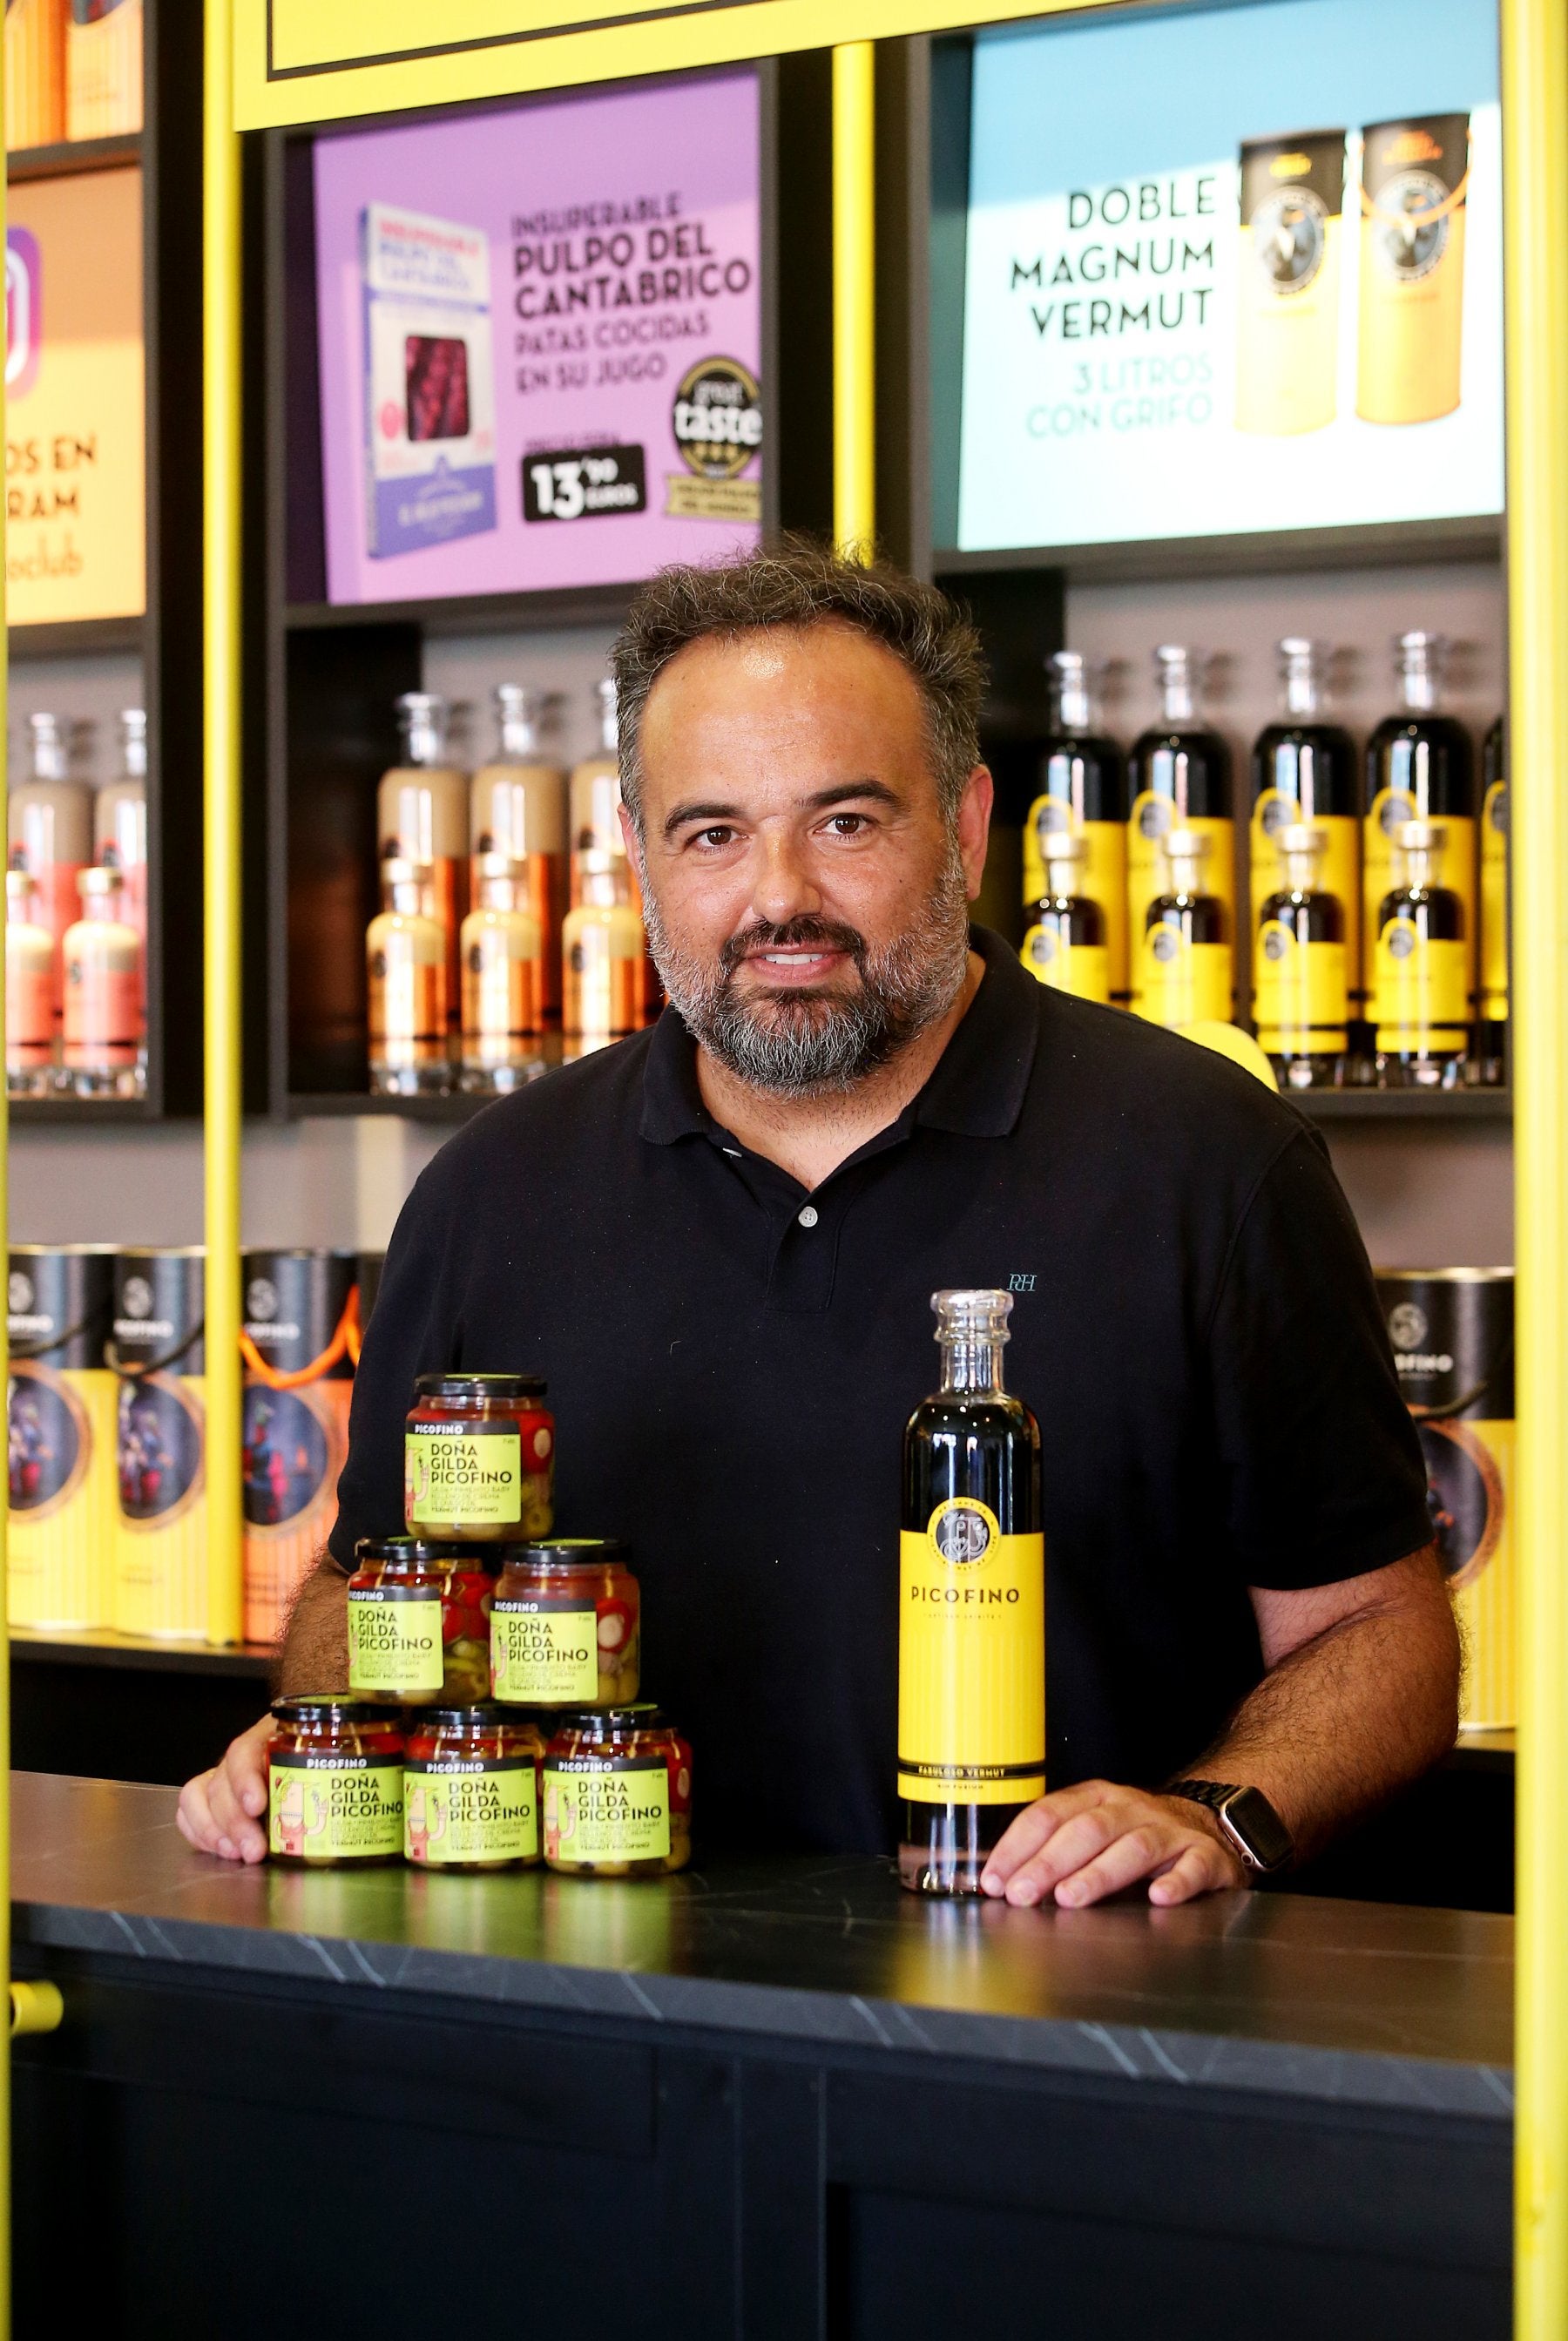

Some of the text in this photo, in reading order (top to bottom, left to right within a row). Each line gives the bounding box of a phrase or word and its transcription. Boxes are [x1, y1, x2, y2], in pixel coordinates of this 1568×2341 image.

[1070, 177, 1215, 229] DOBLE
[515, 233, 634, 276] PULPO
[648, 222, 713, 261] DEL
[1011, 238, 1213, 289] MAGNUM
[516, 258, 750, 319] CANTABRICO
[1031, 288, 1213, 338] VERMUT
[516, 309, 710, 354] PATAS COCIDAS
[517, 352, 667, 393] EN SU JUGO
[1073, 351, 1213, 395] 3 LITROS
[674, 400, 763, 445] taste
[1026, 392, 1213, 438] CON GRIFO
[53, 433, 97, 471] EN
[431, 1440, 478, 1456] DOÑA
[431, 1458, 478, 1470] GILDA
[431, 1471, 512, 1484] PICOFINO
[911, 1586, 1019, 1604] PICOFINO
[358, 1607, 397, 1622] DOÑA
[358, 1625, 398, 1636] GILDA
[509, 1618, 552, 1634] DOÑA
[359, 1638, 433, 1650] PICOFINO
[509, 1635, 553, 1647] GILDA
[509, 1648, 588, 1662] PICOFINO
[306, 1758, 368, 1769] PICOFINO
[426, 1763, 484, 1773] PICOFINO
[558, 1762, 613, 1772] PICOFINO
[918, 1765, 1005, 1778] FABULOSO VERMUT
[331, 1772, 381, 1790] DOÑA
[449, 1777, 499, 1794] DOÑA
[578, 1776, 628, 1793] DOÑA
[331, 1791, 381, 1804] GILDA
[449, 1796, 501, 1808] GILDA
[578, 1796, 629, 1808] GILDA
[331, 1802, 403, 1817] PICOFINO
[449, 1804, 530, 1822] PICOFINO
[579, 1806, 662, 1821] PICOFINO
